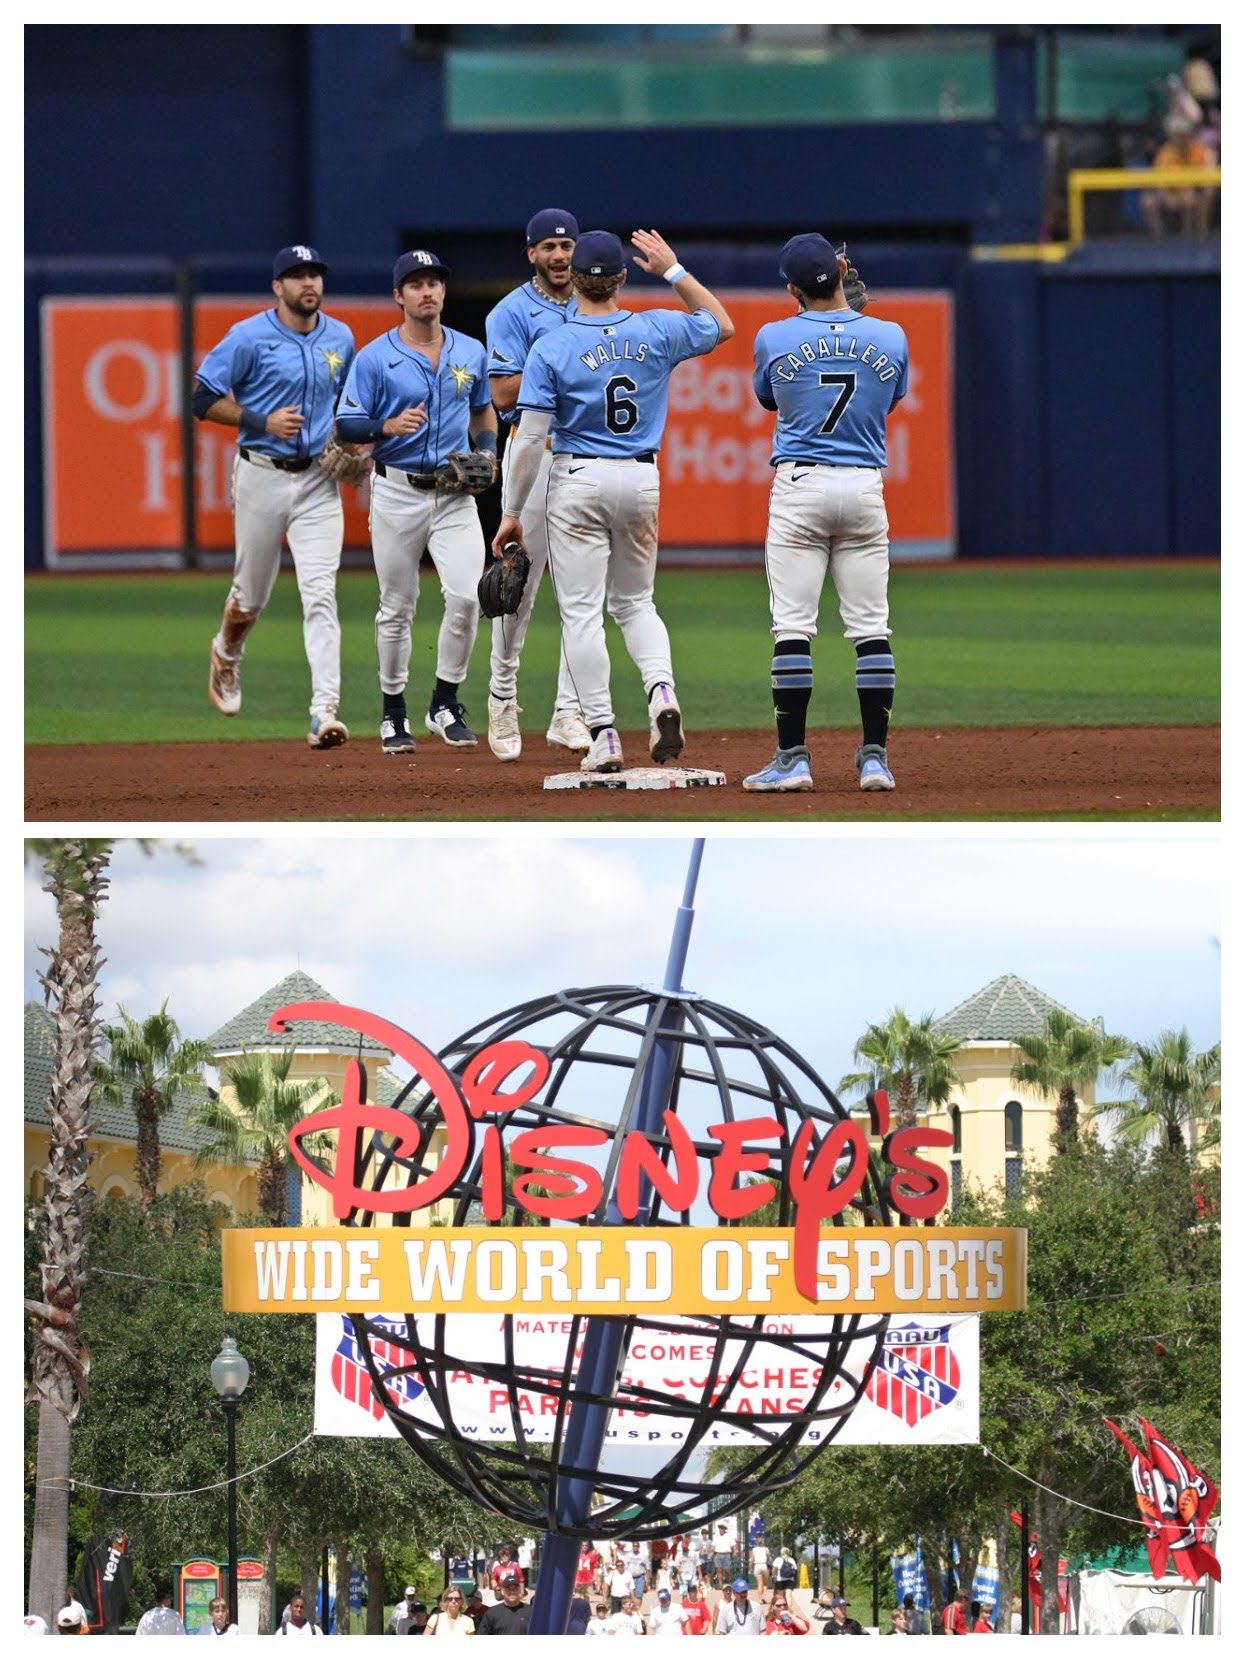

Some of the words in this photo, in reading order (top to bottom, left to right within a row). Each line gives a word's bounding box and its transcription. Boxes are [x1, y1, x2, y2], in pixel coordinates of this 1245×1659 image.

[292, 244, 313, 262] TB
[412, 249, 433, 266] TB
[580, 339, 649, 372] WALLS
[776, 335, 898, 383] CABALLERO
[603, 374, 640, 436] 6
[817, 371, 858, 436] 7
[266, 1001, 955, 1305] Disney's
[253, 1239, 382, 1302] WIDE
[403, 1239, 673, 1303] WORLD
[701, 1239, 790, 1303] OF
[815, 1239, 1004, 1303] SPORTS
[499, 1320, 590, 1335] MATEU
[885, 1330, 940, 1343] AAU
[883, 1349, 941, 1401] USA
[488, 1389, 651, 1418] PARTS
